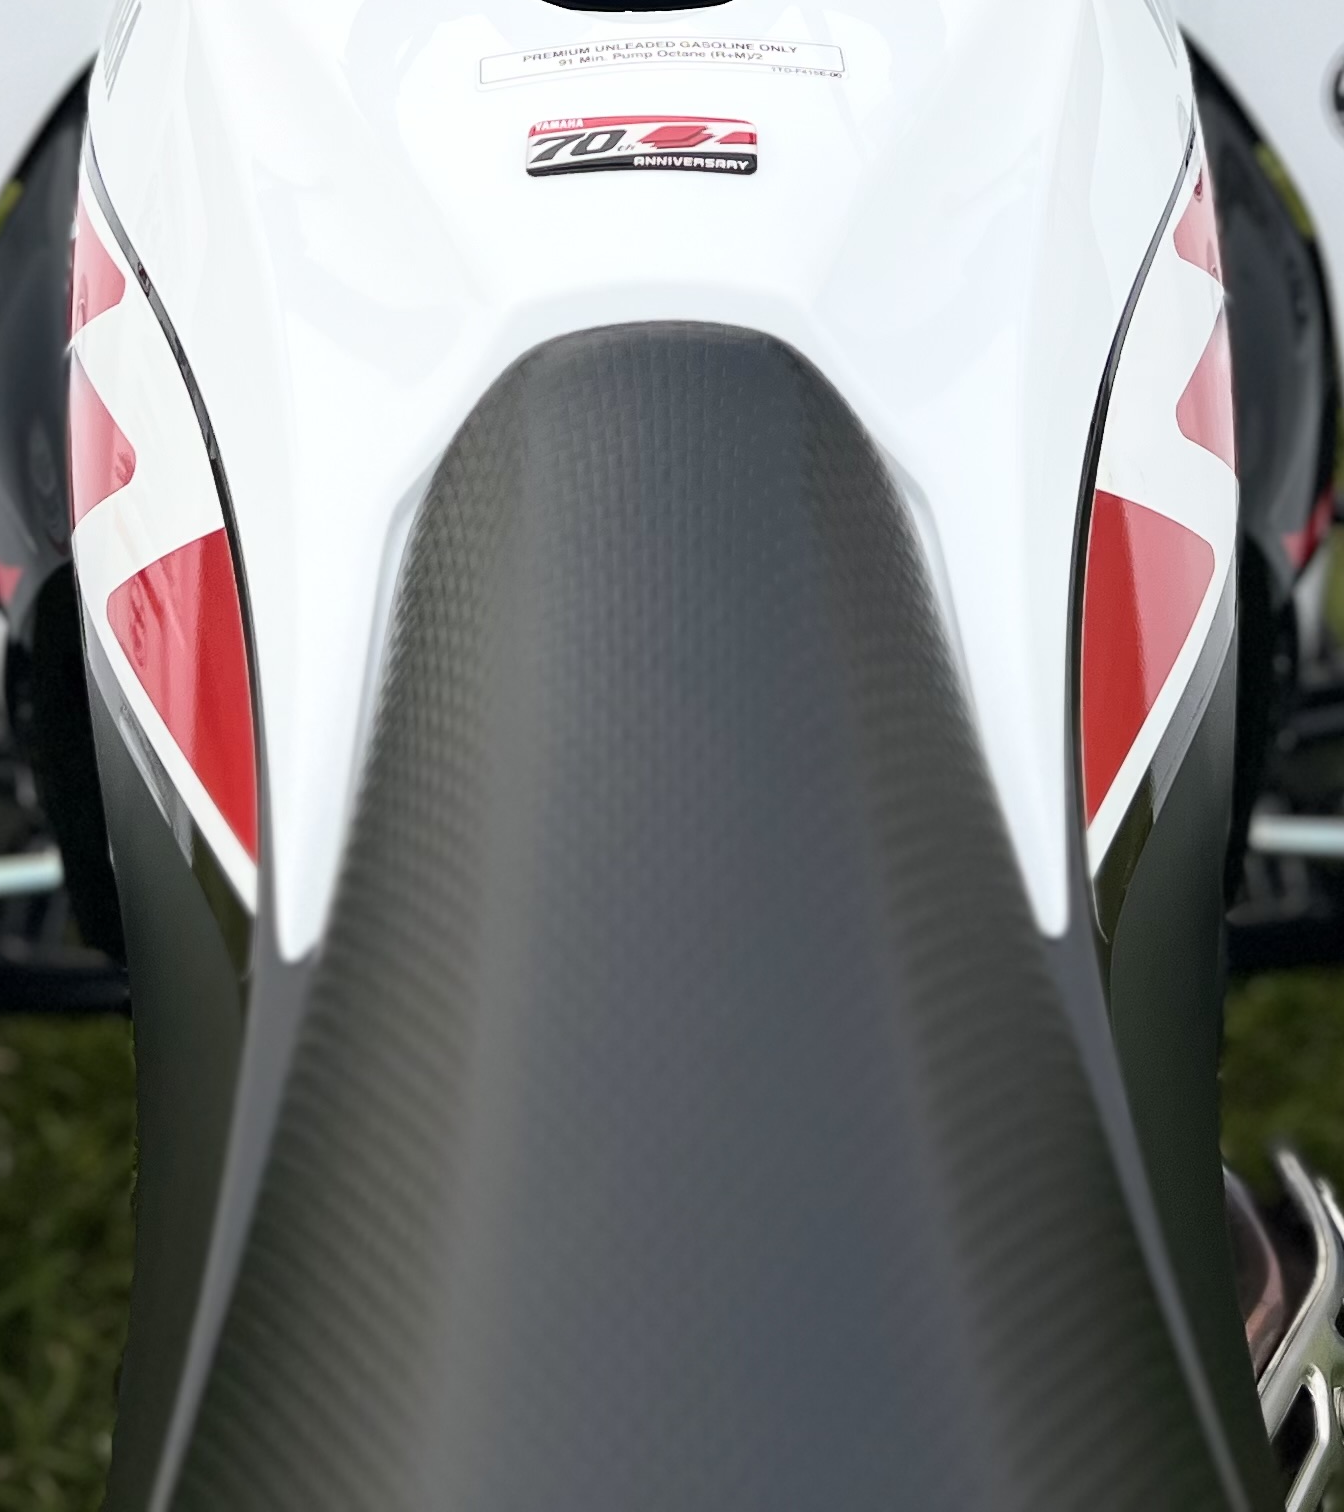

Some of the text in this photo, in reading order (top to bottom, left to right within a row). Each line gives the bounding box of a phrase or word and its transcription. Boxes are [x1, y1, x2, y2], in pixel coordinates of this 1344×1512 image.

[522, 40, 798, 63] PREMIUM UNLEADED GASOLINE ONLY
[612, 50, 653, 61] Pump
[656, 49, 706, 58] Octane
[534, 117, 584, 131] YAMAHA
[530, 129, 628, 164] 70
[632, 155, 750, 171] ANNIVERSARY
